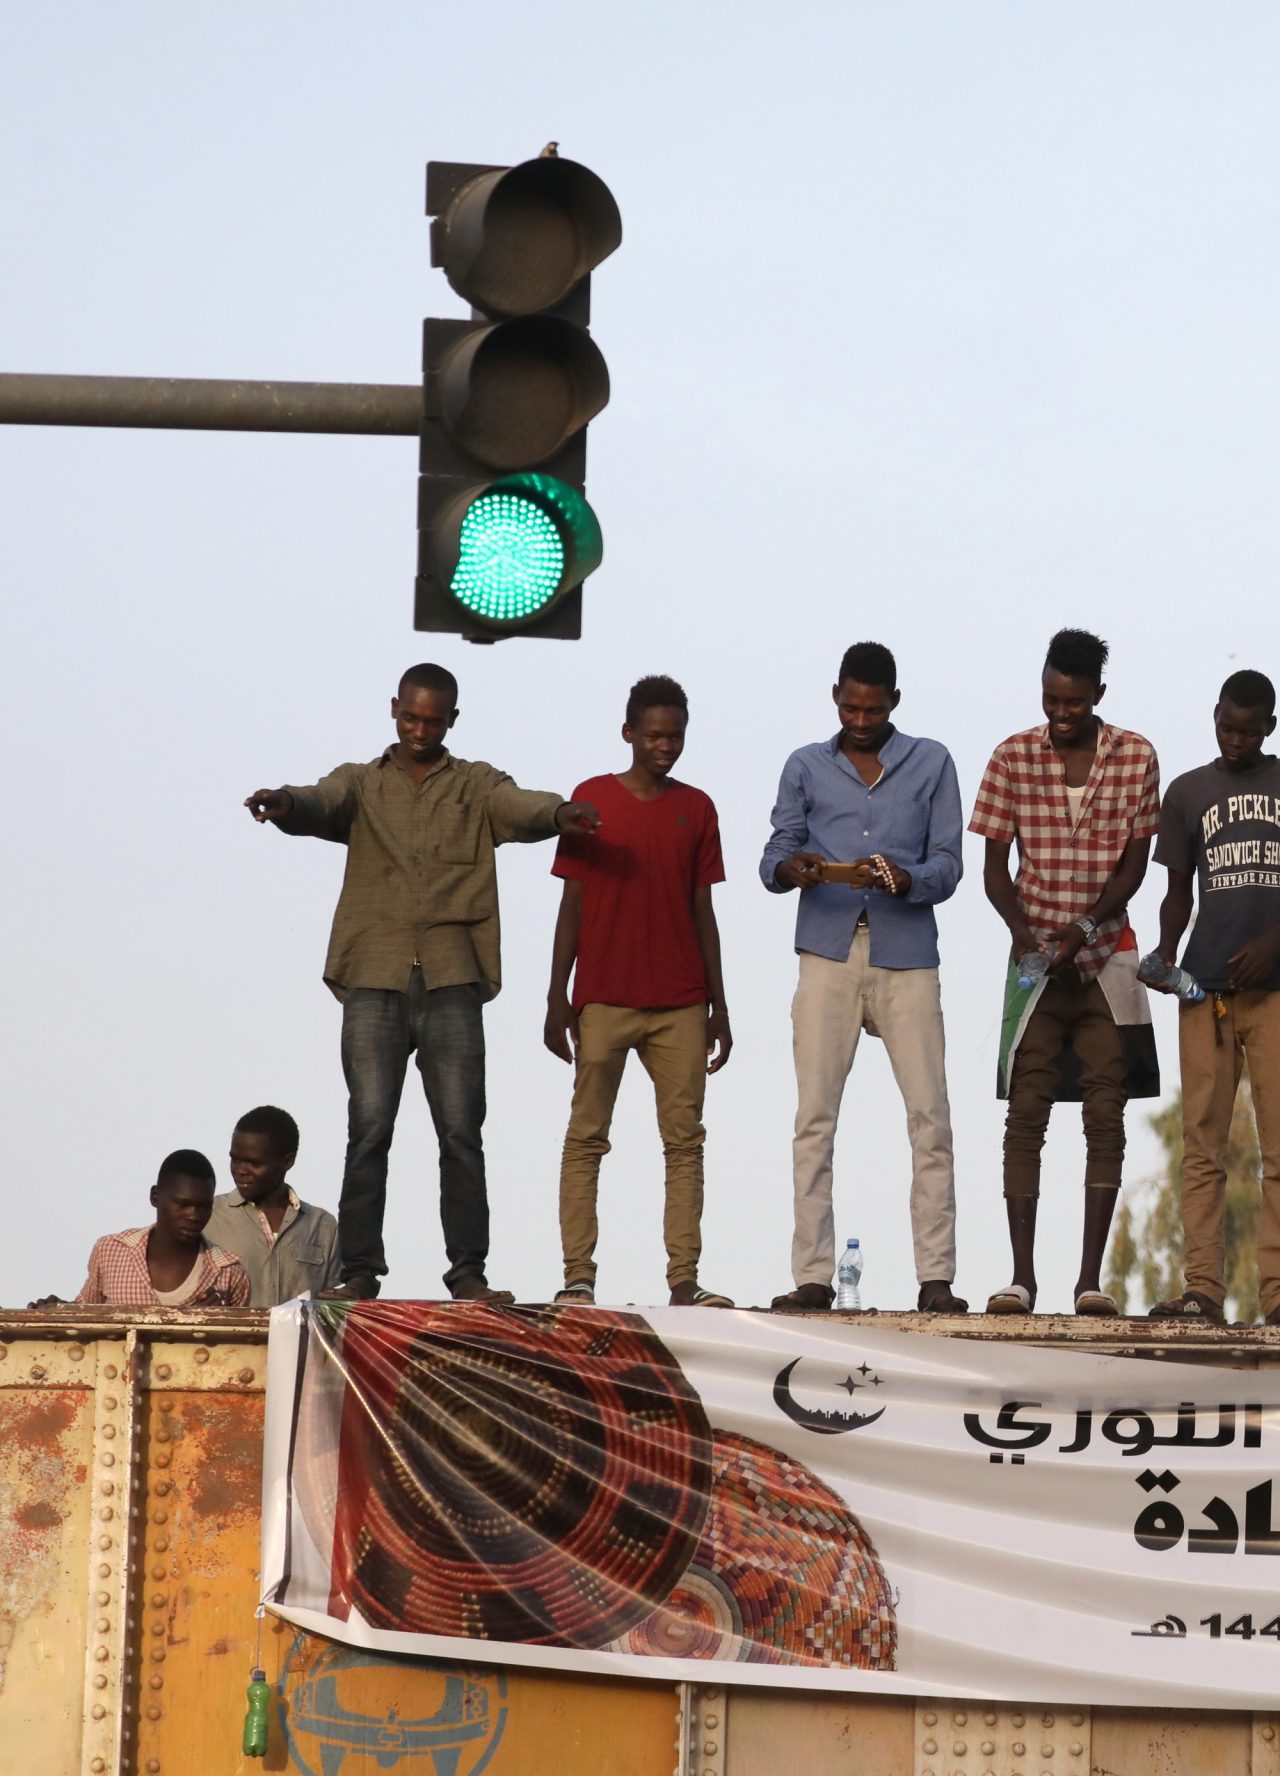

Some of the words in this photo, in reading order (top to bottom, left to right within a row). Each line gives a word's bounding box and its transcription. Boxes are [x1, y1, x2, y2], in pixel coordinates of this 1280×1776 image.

[1202, 804, 1223, 844] MR.
[1205, 840, 1261, 872] SANDWICH
[1211, 873, 1255, 887] VINTAGE
